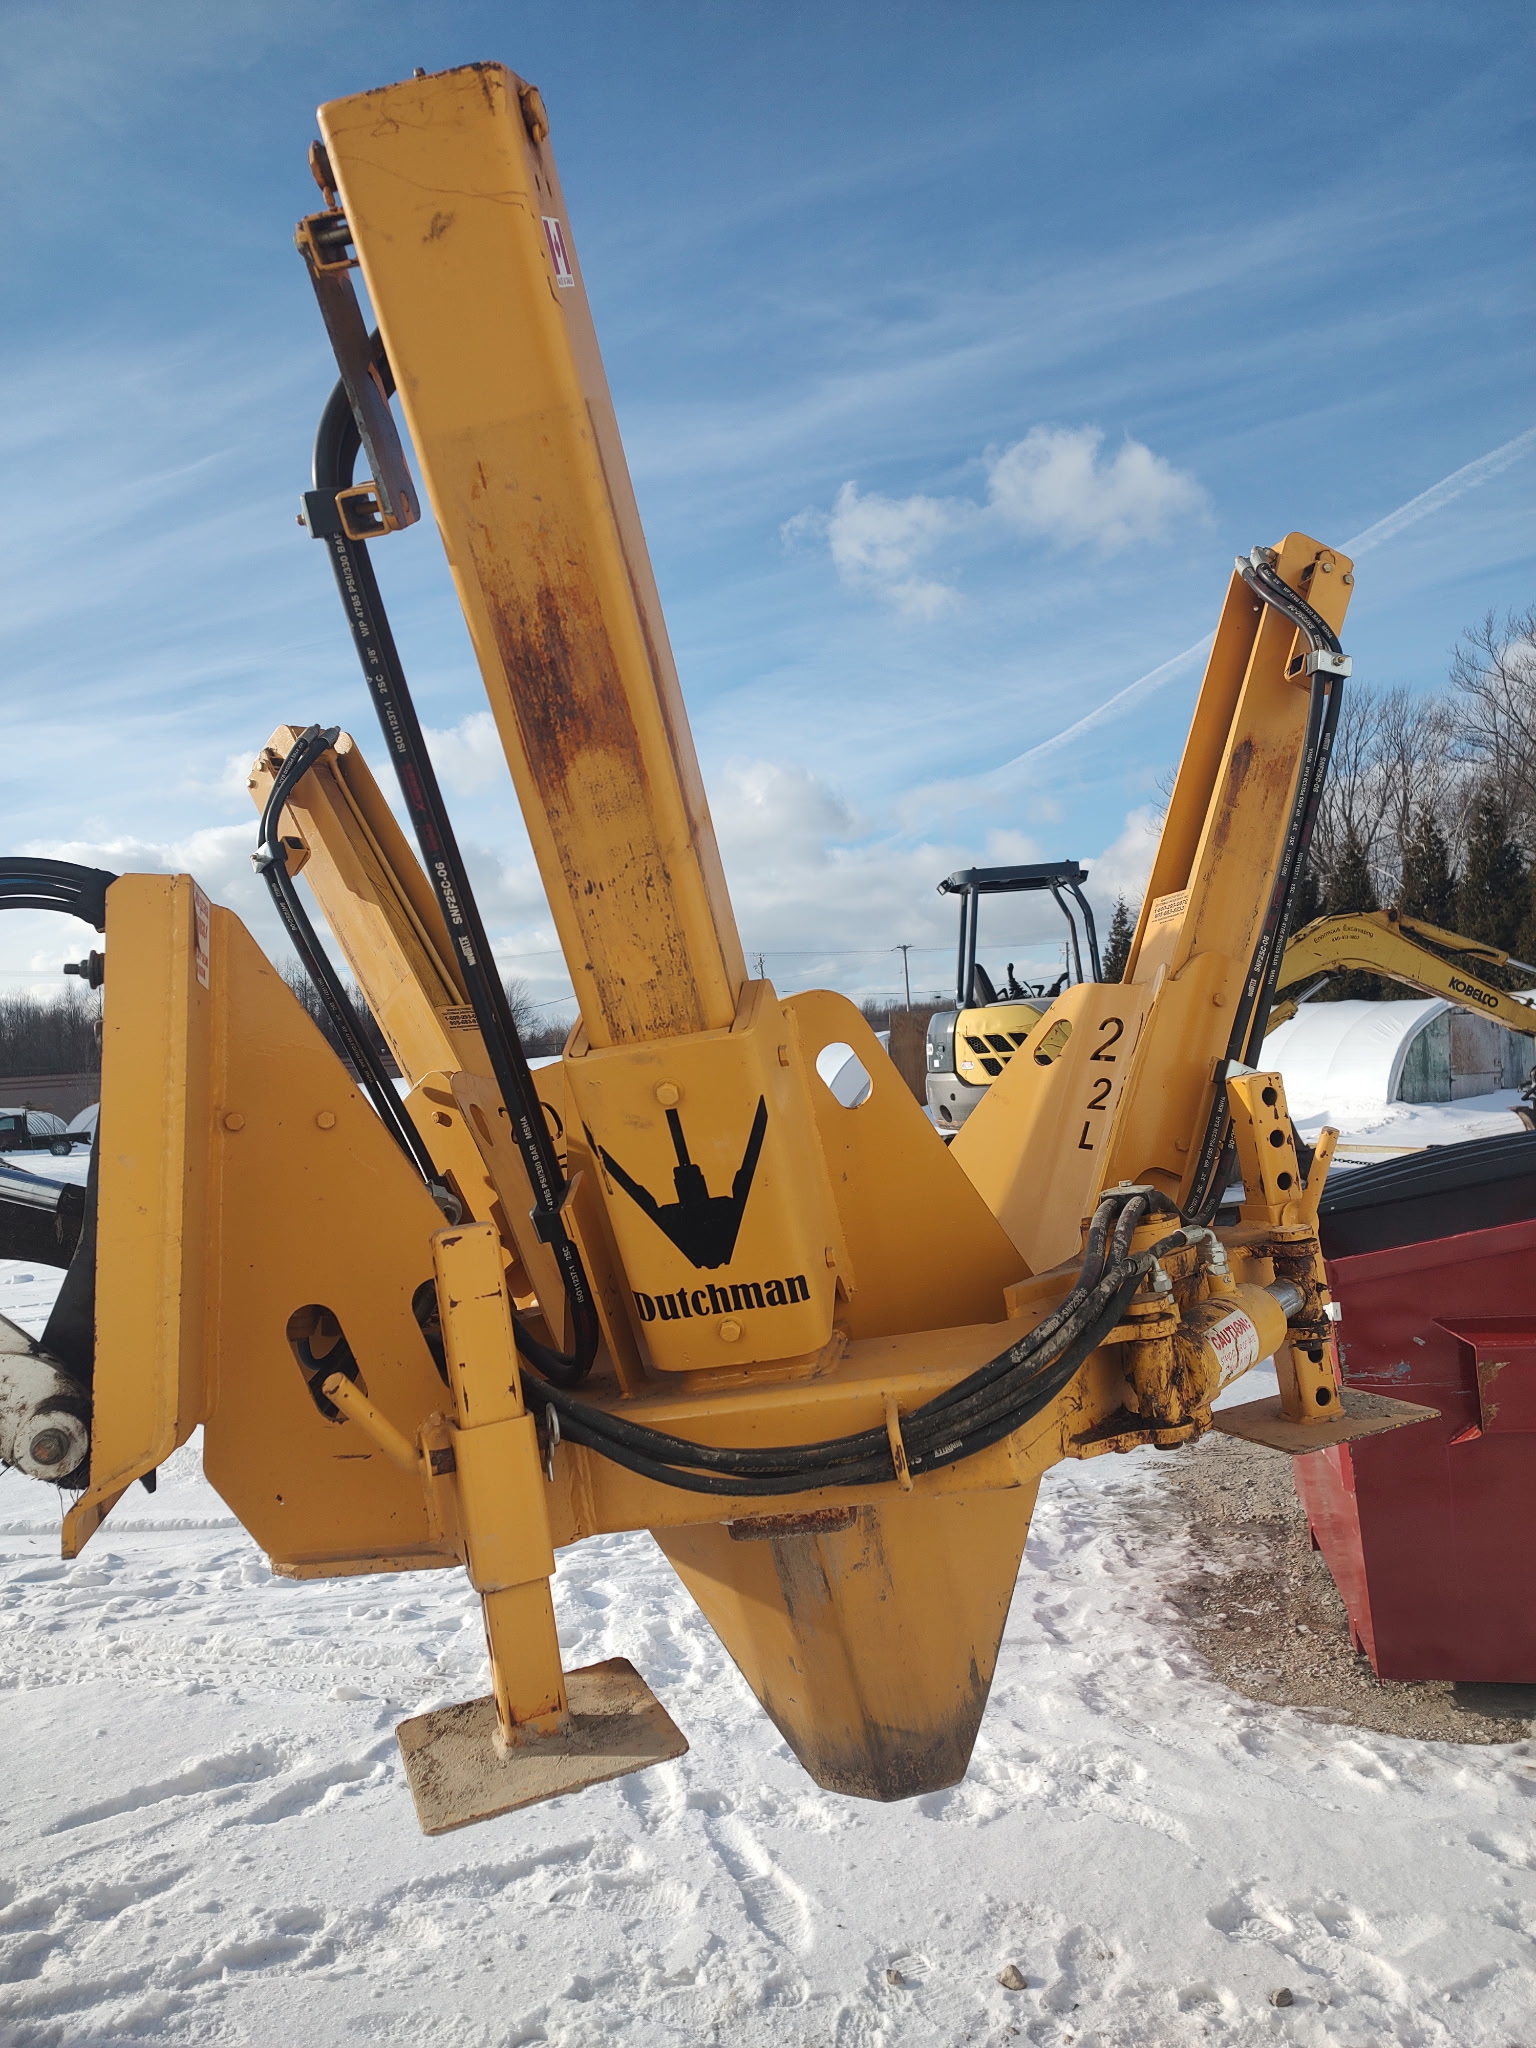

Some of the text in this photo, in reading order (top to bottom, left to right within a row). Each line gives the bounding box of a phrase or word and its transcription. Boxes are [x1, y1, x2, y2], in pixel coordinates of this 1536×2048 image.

[340, 555, 357, 593] PSI/330
[351, 594, 364, 618] 4785
[358, 620, 370, 638] WP
[366, 647, 378, 664] 3/8"
[375, 674, 388, 694] 2SC
[384, 701, 407, 753] ISO11237-1
[435, 861, 463, 925] SNF2SC-06
[1449, 976, 1499, 1008] KOBELCO
[520, 1115, 553, 1207] 4785 PSI/330 BAR MSHA
[562, 1245, 585, 1303] ISO11237-1 2SC
[632, 1274, 811, 1322] Dutchman
[1210, 1317, 1251, 1351] CAUTION:
